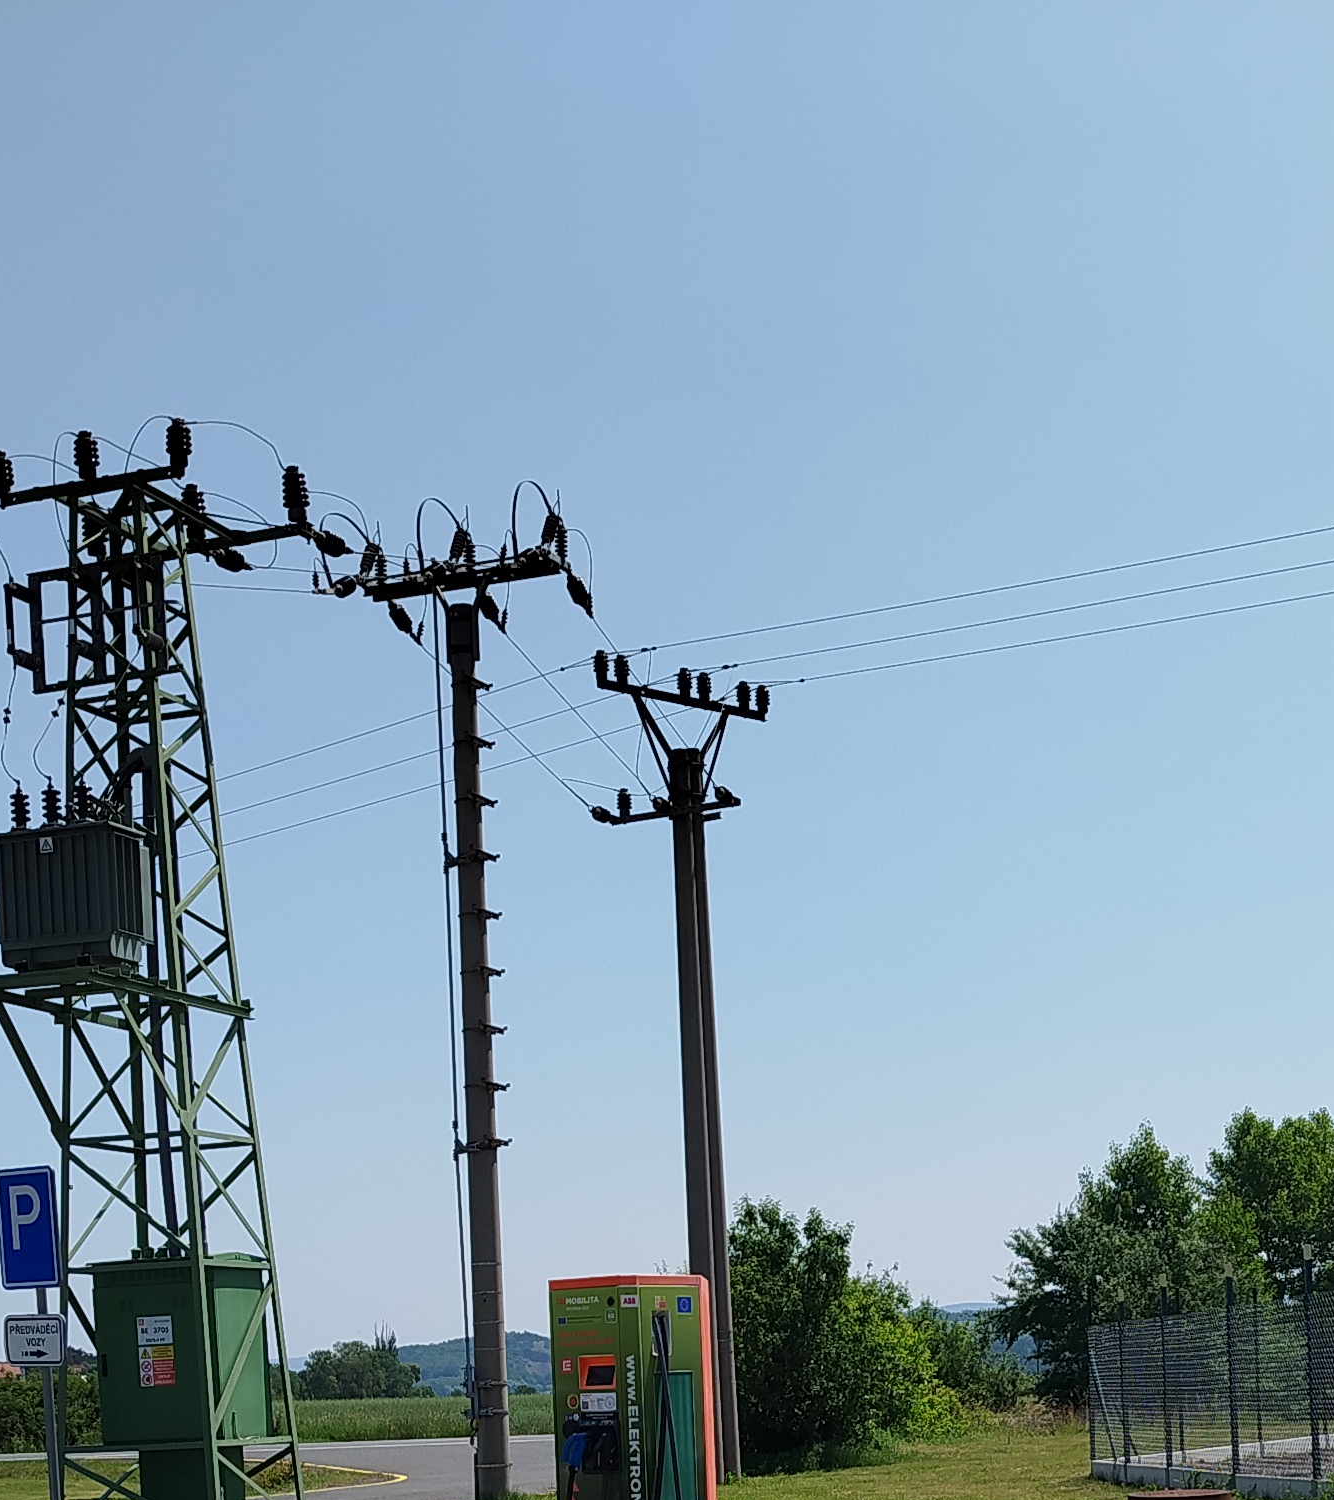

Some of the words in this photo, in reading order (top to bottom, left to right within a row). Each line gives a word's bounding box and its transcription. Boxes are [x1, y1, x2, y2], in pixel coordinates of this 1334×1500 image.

[8, 1184, 41, 1250] P
[9, 1322, 59, 1335] PŘEDVÁDĚCÍ
[25, 1337, 46, 1347] VOZY
